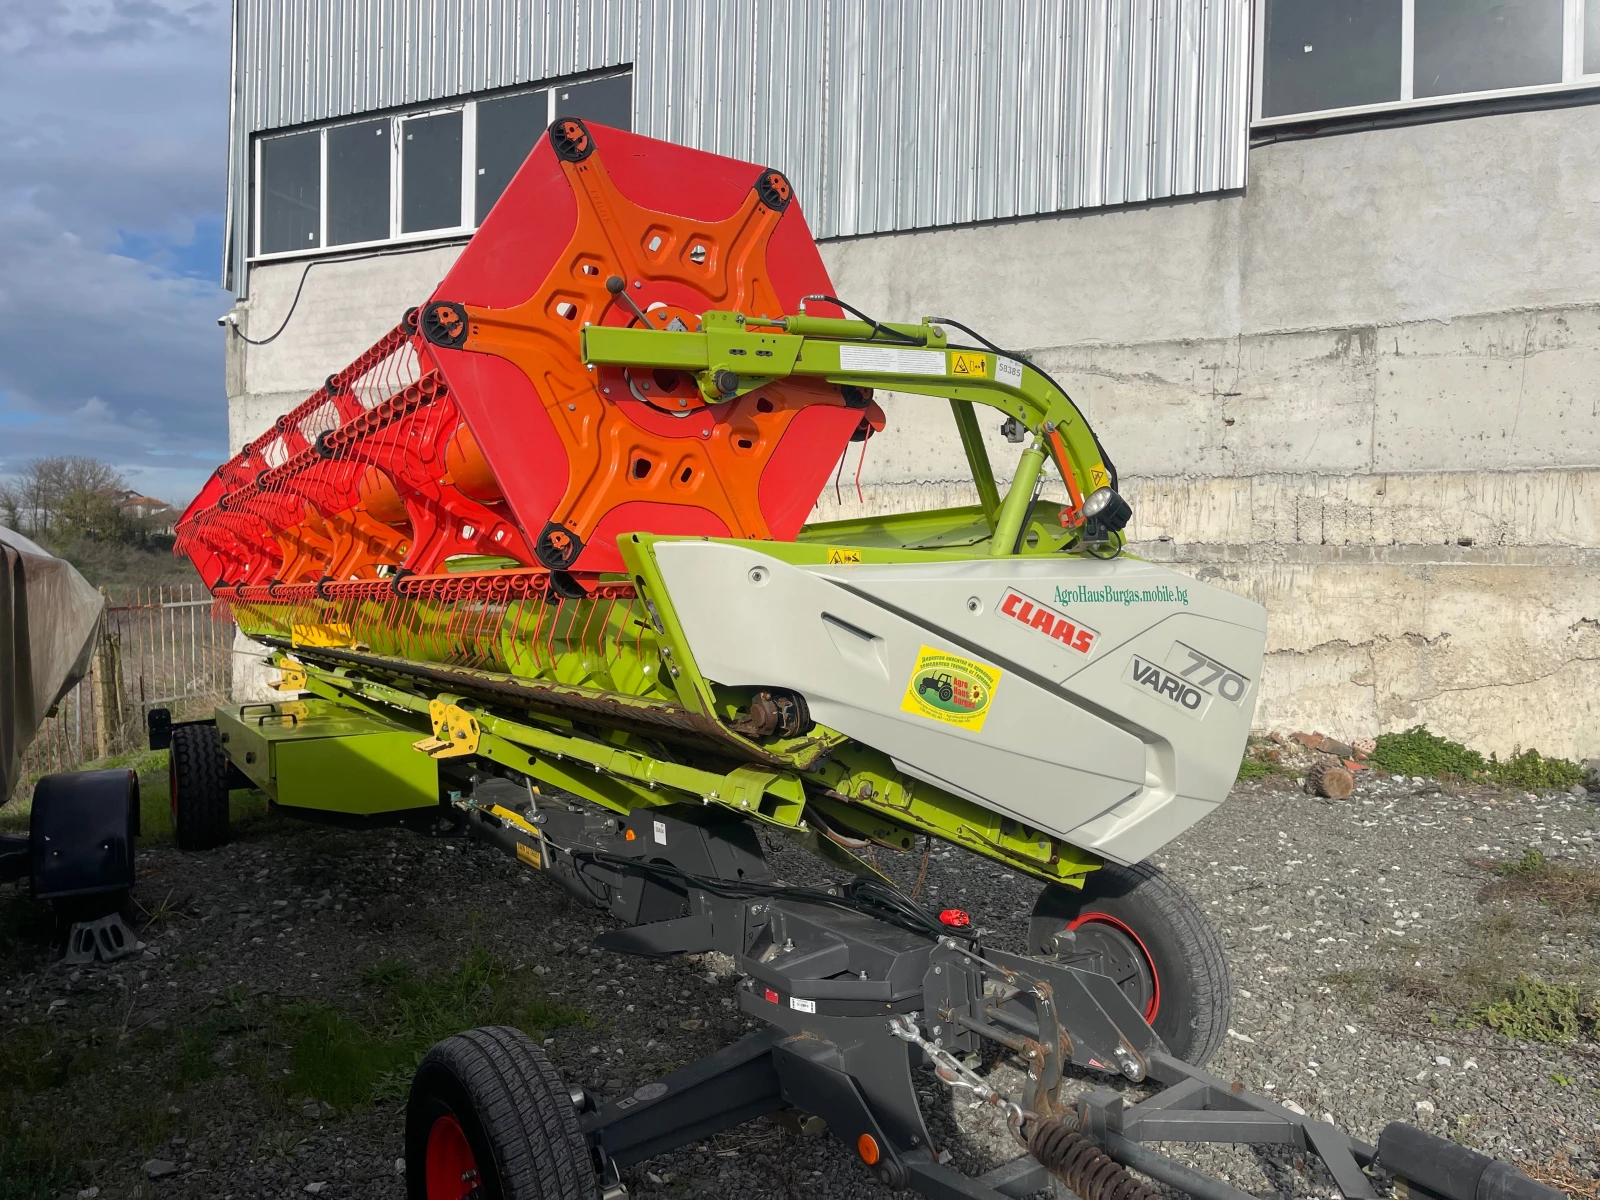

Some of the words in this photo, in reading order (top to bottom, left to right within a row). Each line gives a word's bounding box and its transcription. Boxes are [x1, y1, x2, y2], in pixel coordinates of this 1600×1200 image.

[999, 363, 1021, 377] 58385
[1054, 585, 1189, 607] AgroHausBurgas.mobile.bg
[1001, 593, 1094, 653] CLAAS
[953, 677, 969, 689] Agro
[1133, 659, 1202, 709] VARIO
[1180, 651, 1245, 701] 770
[953, 686, 970, 698] Haus
[953, 695, 976, 709] Burgas
